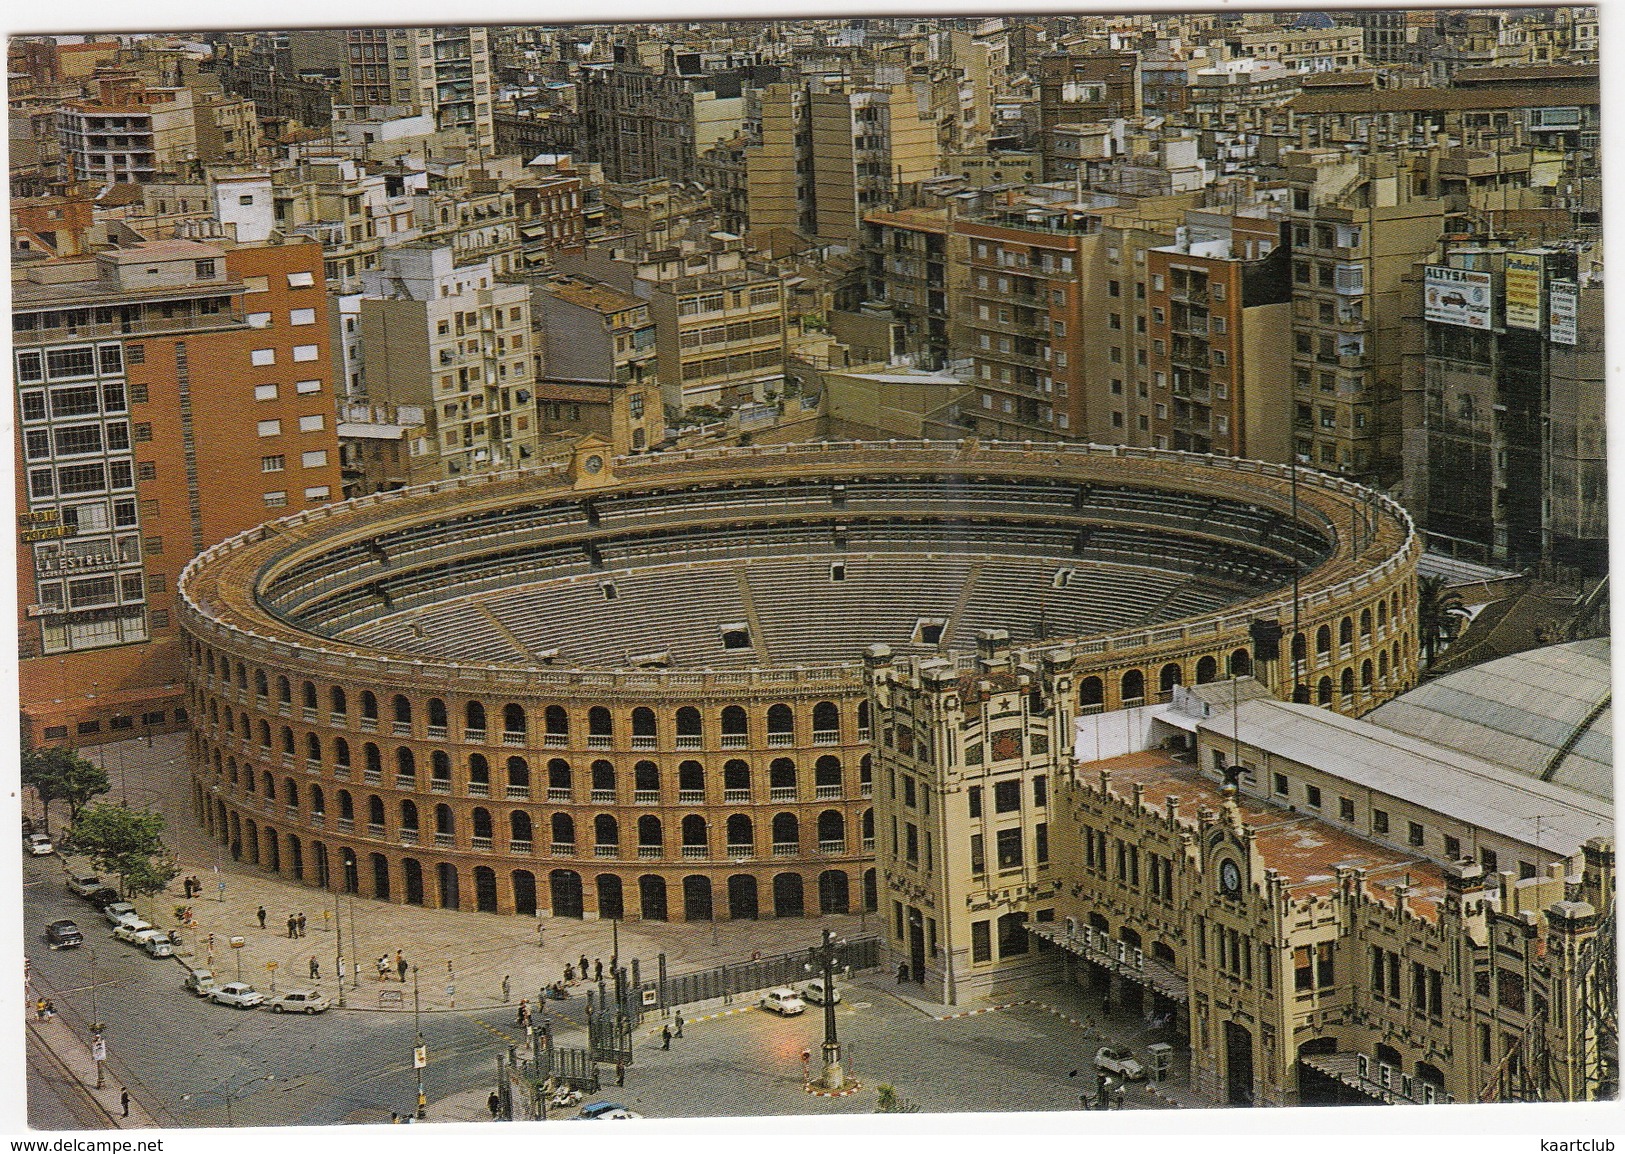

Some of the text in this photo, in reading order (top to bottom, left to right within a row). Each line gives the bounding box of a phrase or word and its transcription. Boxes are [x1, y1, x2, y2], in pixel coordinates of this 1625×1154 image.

[1426, 268, 1467, 283] ALTYSA
[37, 559, 51, 571] LA
[60, 550, 128, 569] ESTRELLA
[1066, 916, 1143, 971] RENFE
